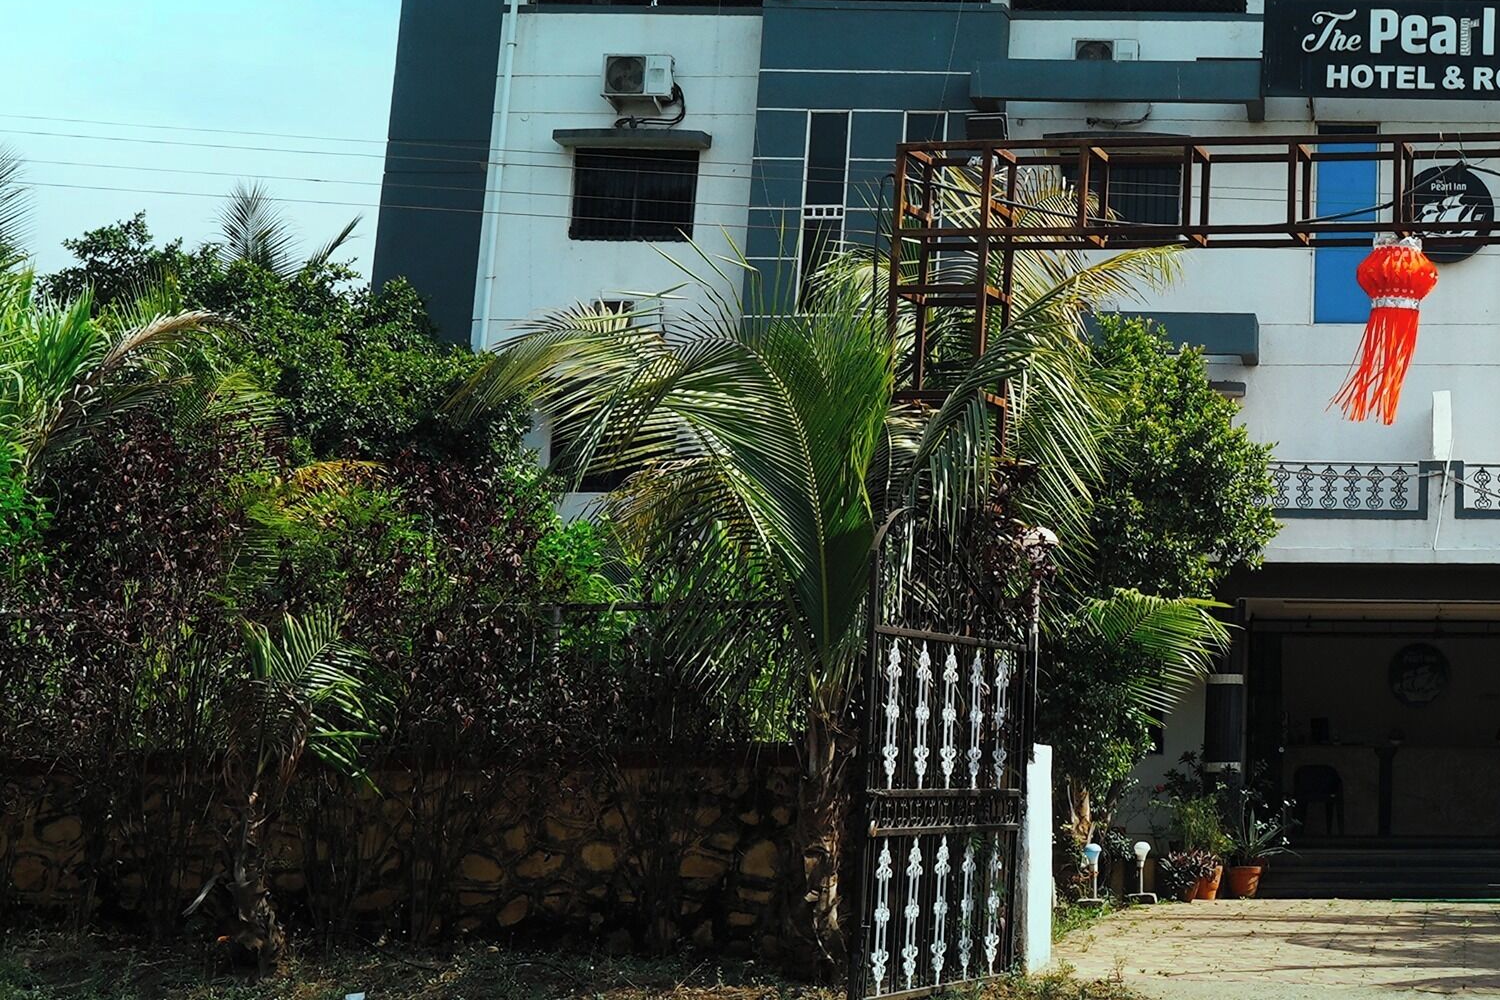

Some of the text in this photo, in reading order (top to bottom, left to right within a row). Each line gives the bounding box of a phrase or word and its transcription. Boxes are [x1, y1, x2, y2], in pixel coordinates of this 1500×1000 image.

[1301, 8, 1362, 53] The
[1369, 7, 1496, 56] Pearl
[1326, 64, 1436, 89] HOTEL
[1441, 65, 1466, 90] &
[1430, 182, 1467, 191] Pearl Inn
